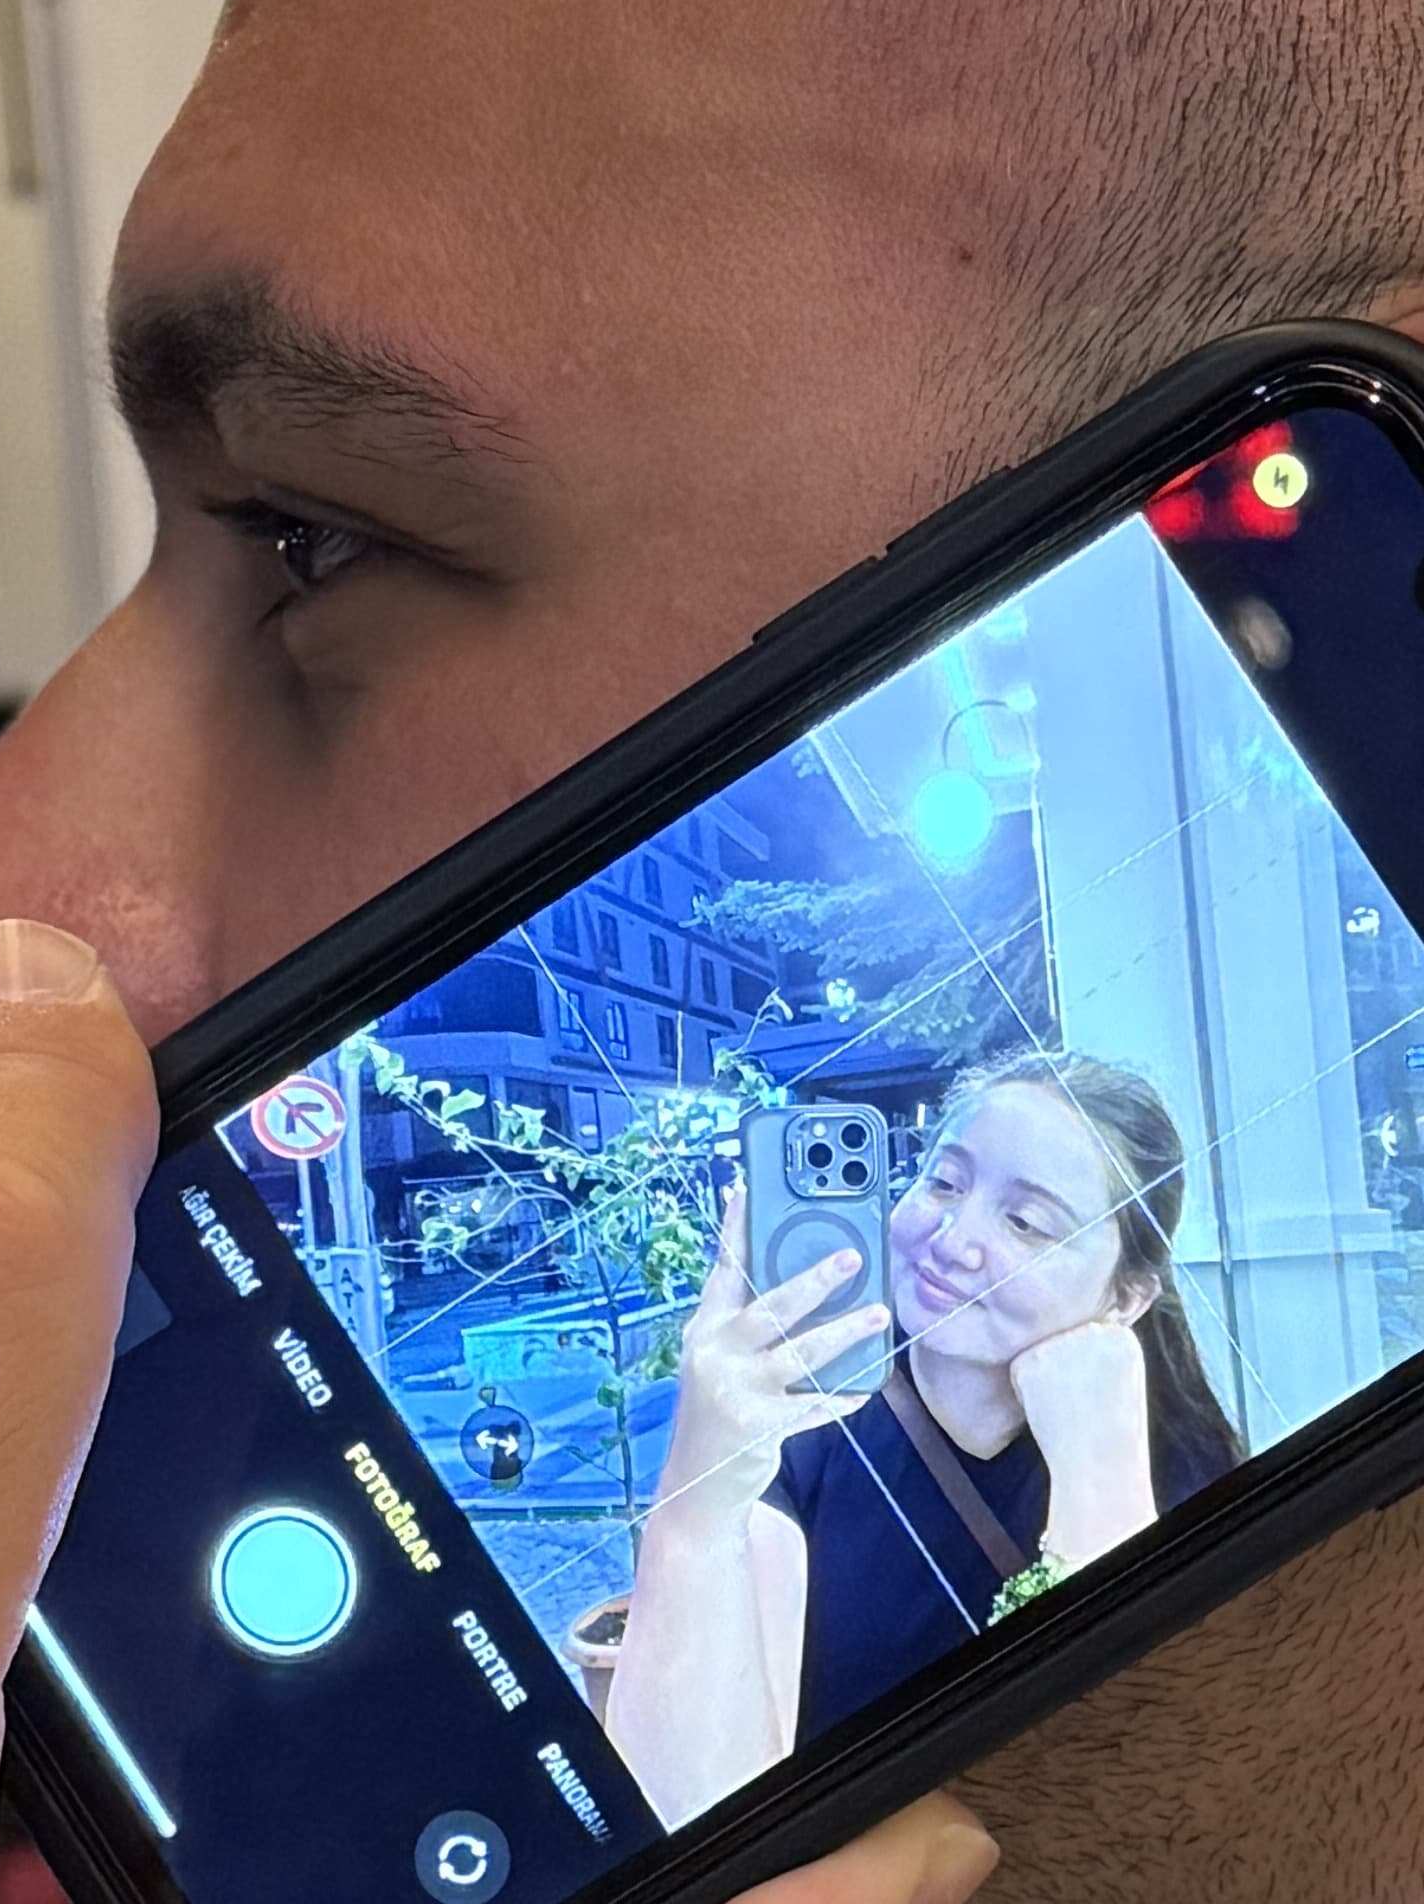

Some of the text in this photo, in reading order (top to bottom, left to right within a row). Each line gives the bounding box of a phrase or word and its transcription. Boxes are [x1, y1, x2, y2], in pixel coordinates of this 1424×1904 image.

[178, 1185, 263, 1298] AĞIR ÇEKİM
[273, 1327, 333, 1410] VİDEO
[344, 1441, 442, 1574] FOTOĞRAF
[451, 1609, 528, 1713] PORTRE
